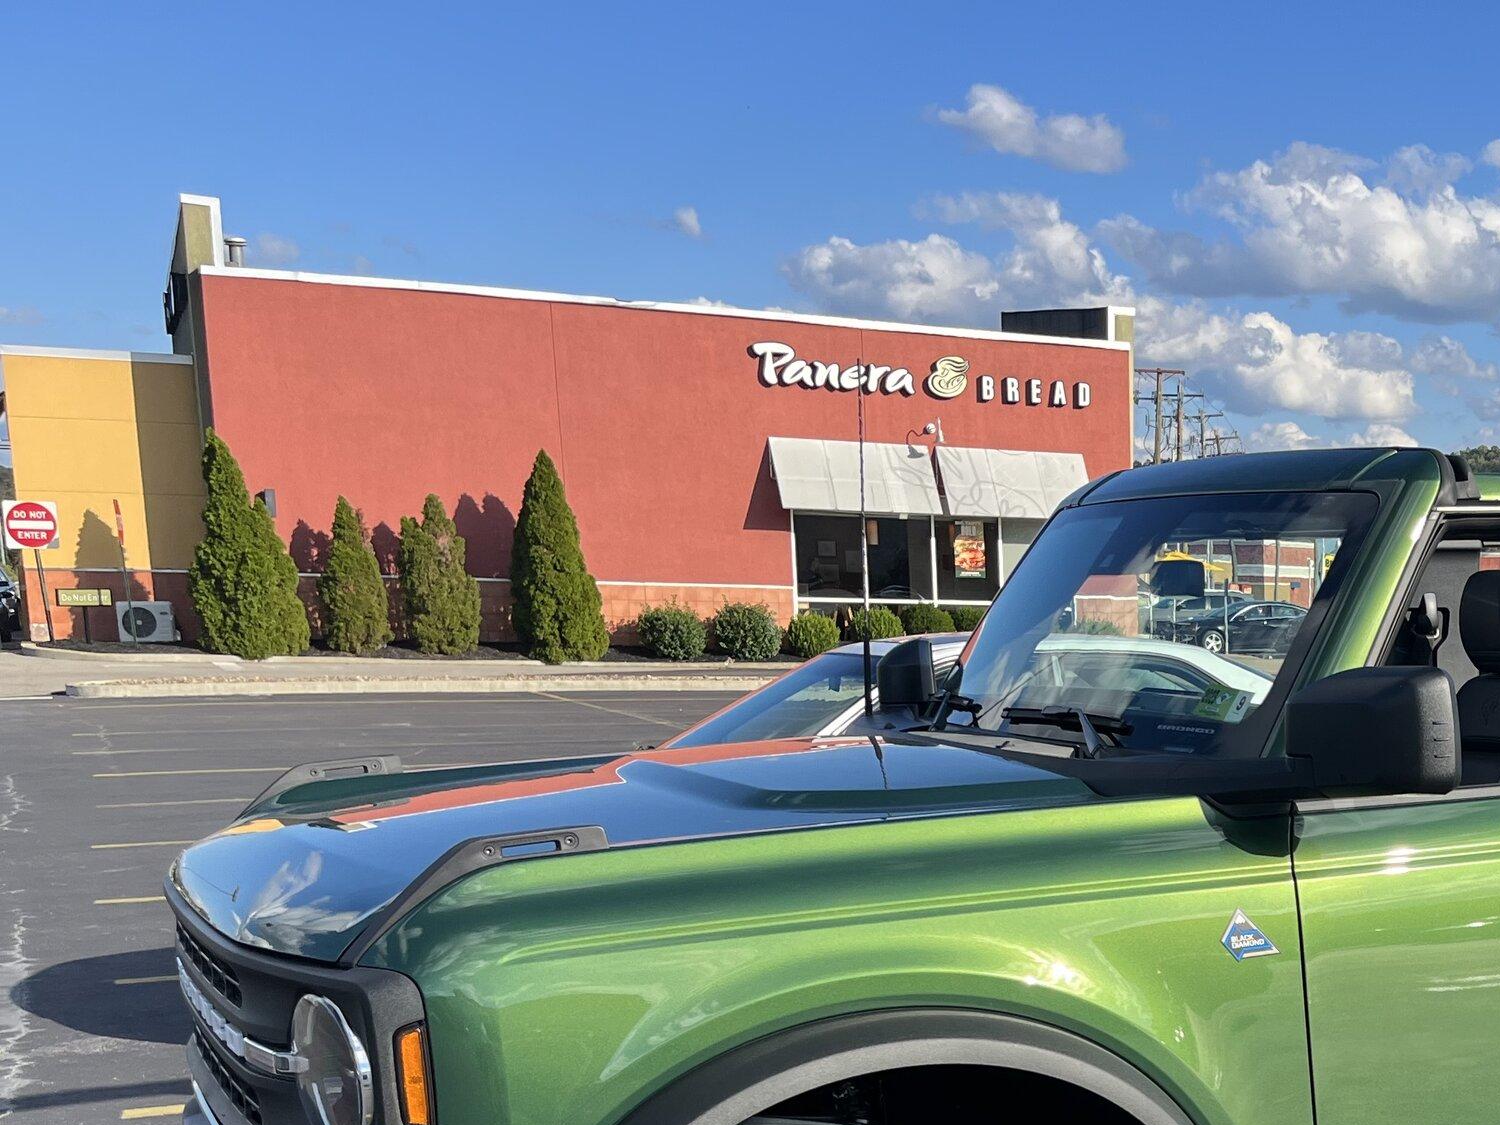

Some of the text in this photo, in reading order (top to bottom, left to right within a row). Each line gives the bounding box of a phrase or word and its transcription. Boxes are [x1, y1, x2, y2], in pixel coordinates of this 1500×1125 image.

[750, 341, 1092, 408] Panera BREAD
[13, 510, 47, 519] DO NOT
[17, 531, 48, 540] ENTER
[61, 593, 71, 602] Do
[72, 593, 86, 602] Not
[1230, 934, 1254, 943] BLACK
[1231, 938, 1265, 949] DIAMOND
